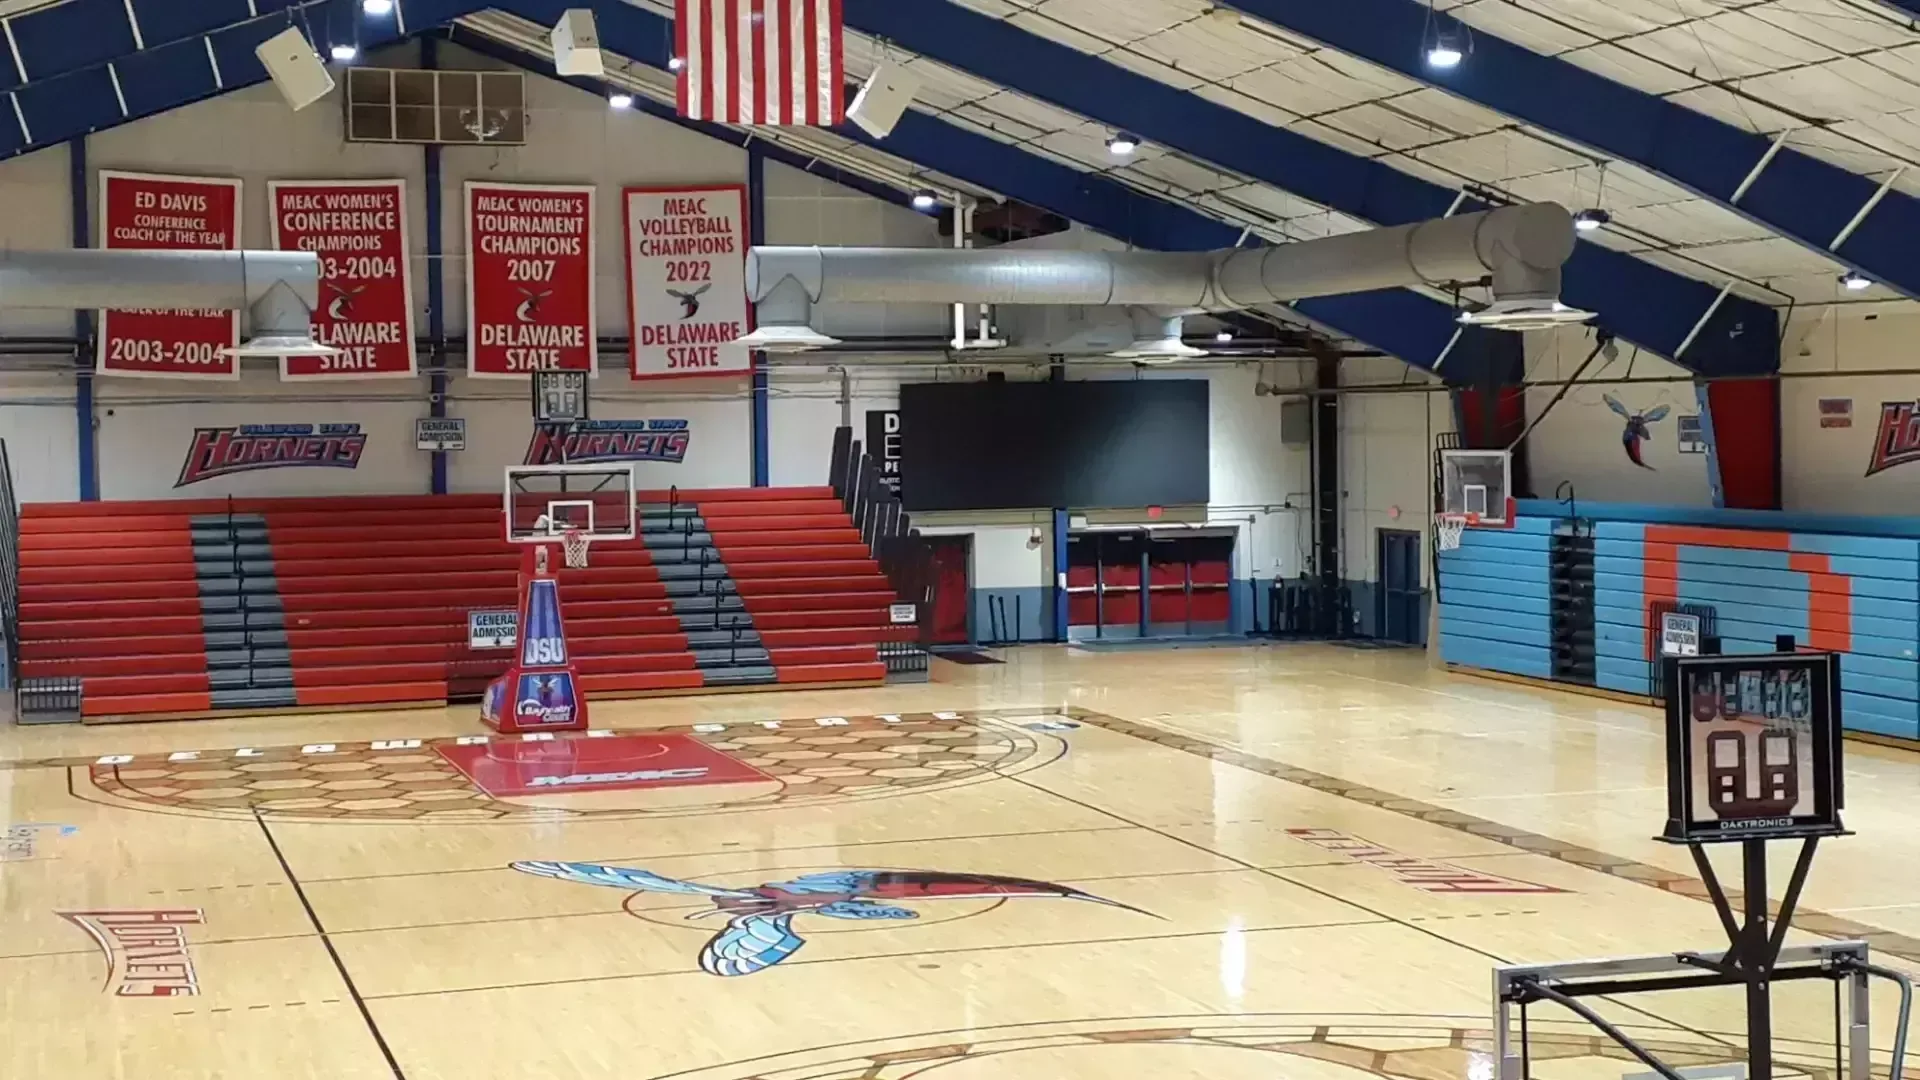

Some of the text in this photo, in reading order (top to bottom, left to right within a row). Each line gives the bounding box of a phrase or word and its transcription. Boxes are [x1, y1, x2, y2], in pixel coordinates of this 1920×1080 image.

[135, 191, 207, 212] ED DAVIS
[282, 193, 394, 210] MEAC WOMEN'S
[477, 196, 584, 214] MEAC WOMEN'S
[663, 198, 707, 216] MEAC
[134, 214, 206, 230] CONFERENCE
[283, 212, 395, 231] CONFERENCE
[476, 214, 584, 235] TOURNAMENT
[639, 215, 733, 236] VOLLEYBALL
[114, 227, 226, 246] COACH OF THE YEAR
[297, 234, 382, 251] CHAMPIONS
[480, 235, 581, 256] CHAMPIONS
[639, 236, 735, 257] CHAMPIONS
[507, 259, 556, 281] 2007
[665, 260, 712, 282] 2022
[310, 321, 401, 344] ELAWARE
[481, 323, 585, 348] DELAWARE
[641, 321, 741, 345] DELAWARE
[110, 337, 226, 365] 2003-2004
[505, 348, 561, 371] STATE
[667, 346, 719, 369] STATE
[419, 431, 463, 442] ADMISSION
[421, 421, 460, 431] GENERAL
[173, 427, 368, 488] HORNETS
[472, 626, 517, 639] ADMISSIO
[1667, 618, 1694, 633] GENERAL
[524, 637, 565, 664] DSU
[1720, 818, 1794, 830] DAKTRONICS
[52, 907, 207, 998] HORNETS
